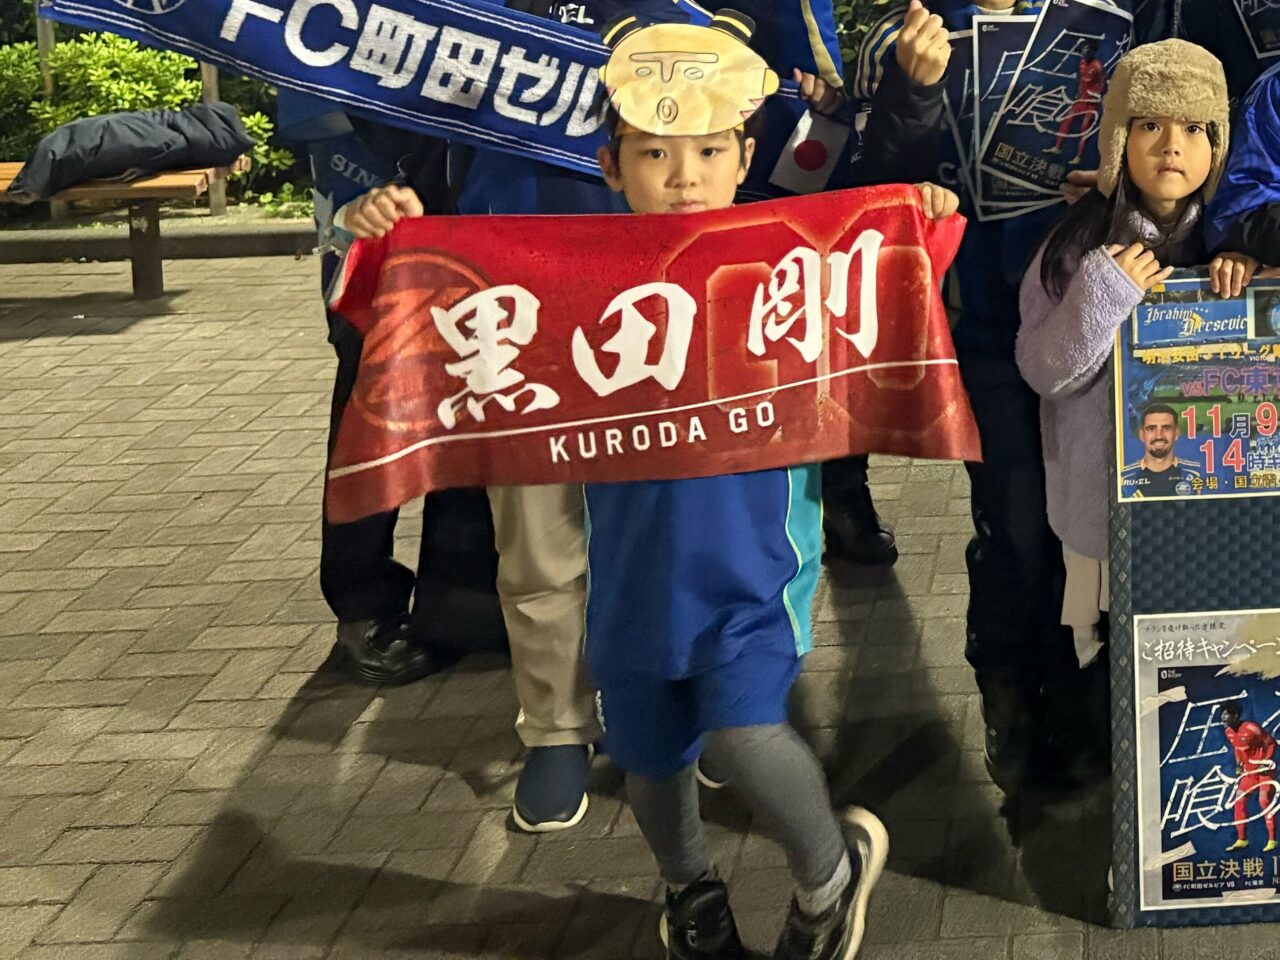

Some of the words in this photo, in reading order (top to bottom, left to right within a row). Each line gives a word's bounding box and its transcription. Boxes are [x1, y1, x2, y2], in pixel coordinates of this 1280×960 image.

[430, 229, 885, 430] 黒田剛
[549, 421, 707, 463] KURODA
[729, 401, 777, 435] GO
[1173, 857, 1264, 882] 国立決戦
